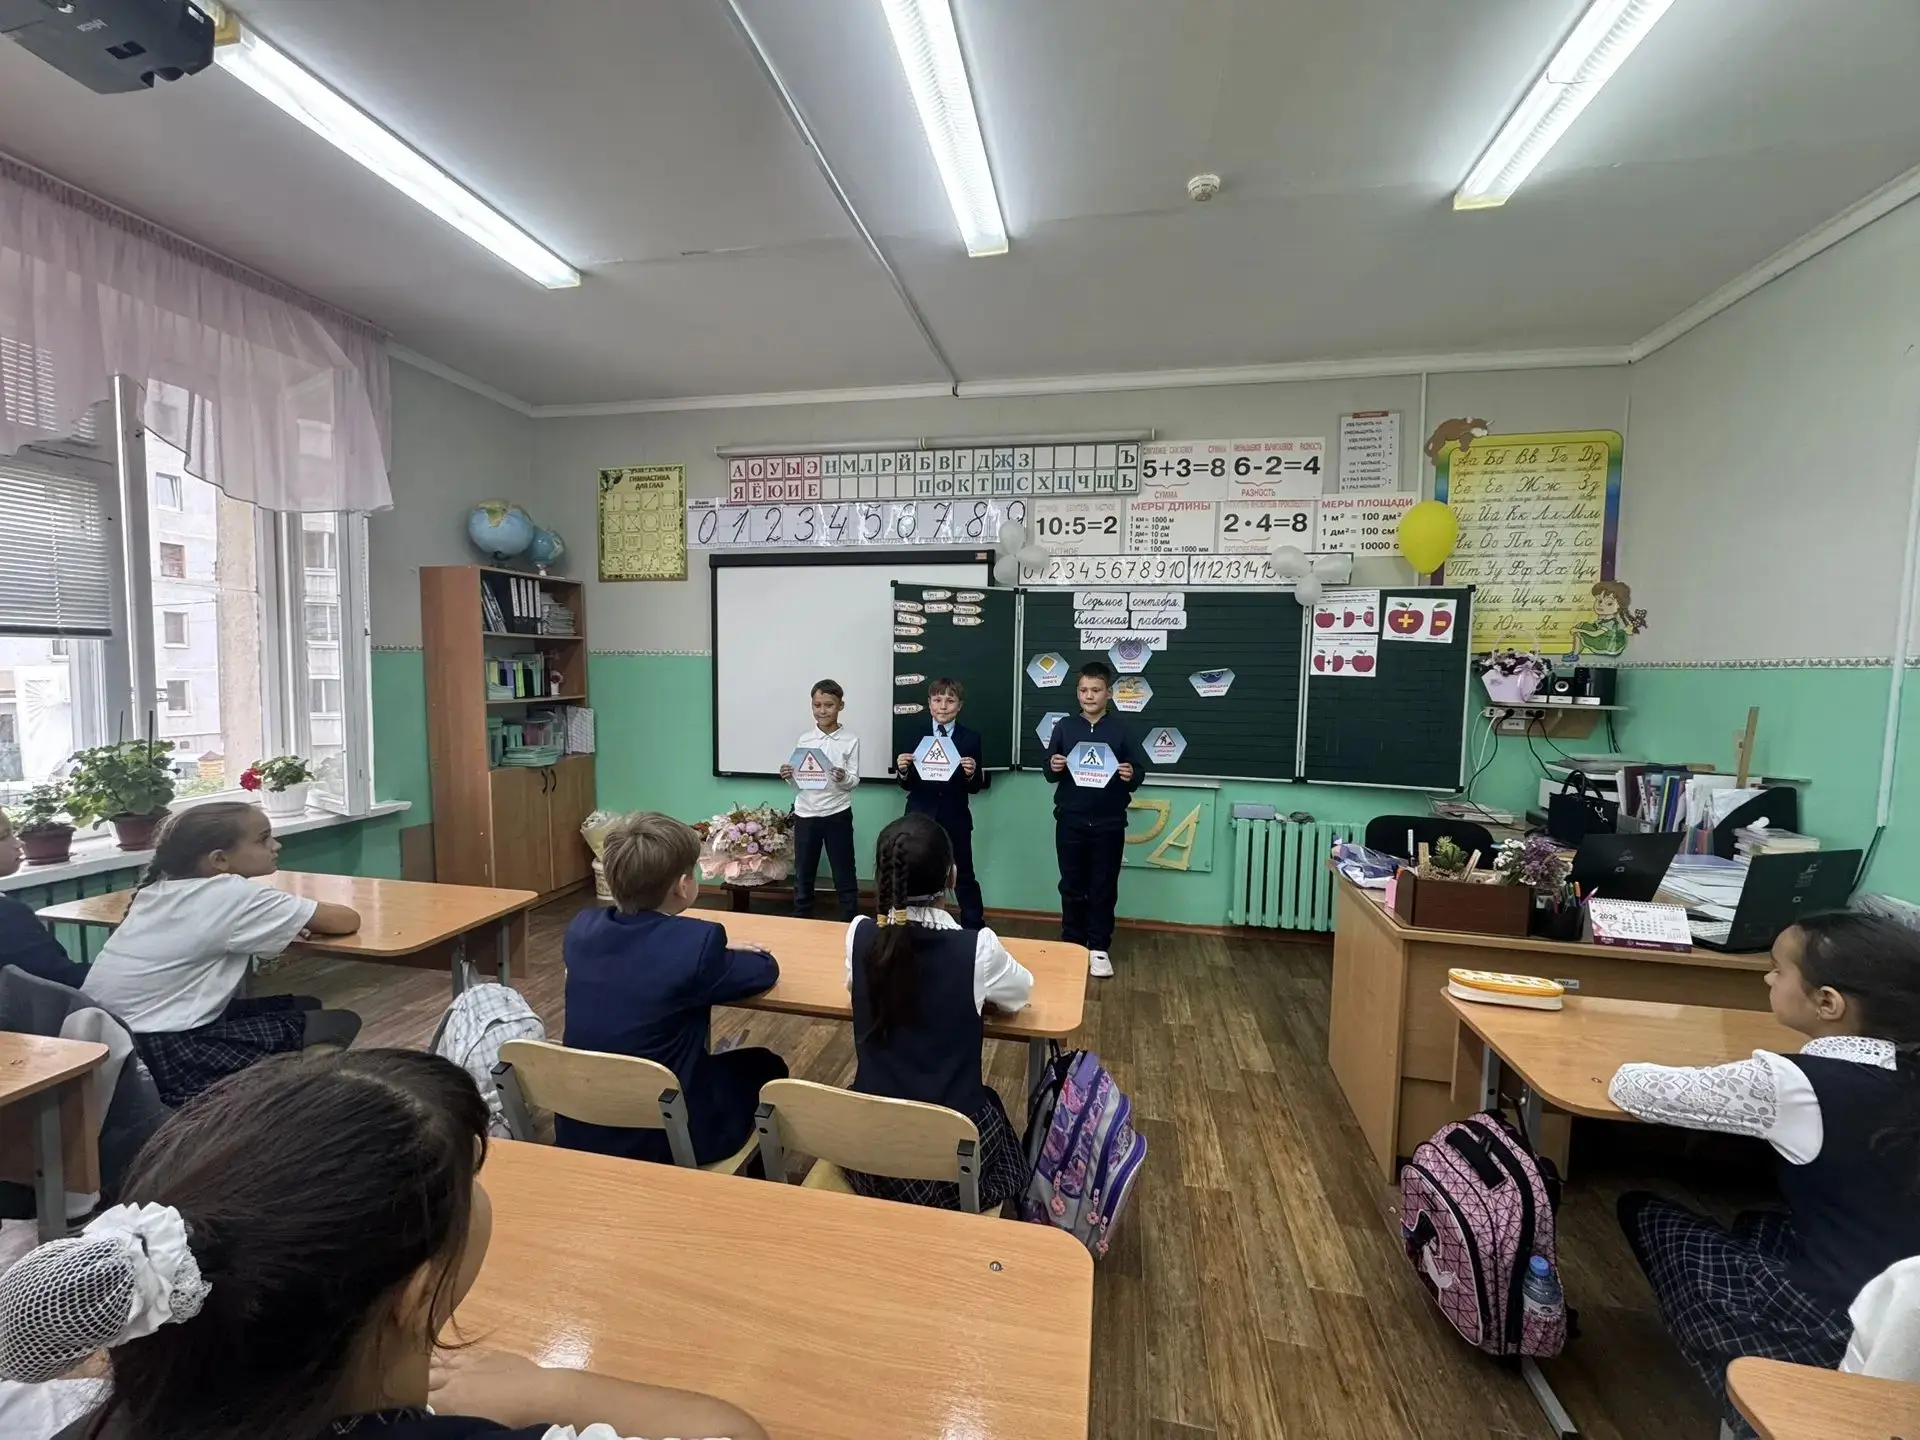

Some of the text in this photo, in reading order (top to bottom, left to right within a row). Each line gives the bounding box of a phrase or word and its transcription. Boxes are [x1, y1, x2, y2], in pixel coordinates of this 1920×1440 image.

[629, 474, 671, 482] ГИМНАСТИКА
[635, 483, 648, 491] ДЛЯ
[1154, 491, 1178, 499] СУММА
[1241, 488, 1276, 497] РАЗНОСТЬ
[1131, 502, 1164, 511] МЕРЫ
[1167, 502, 1211, 512] ДЛИНЫ
[1321, 499, 1354, 508] МЕРЫ
[1357, 498, 1413, 509] ПЛОЩАДИ
[1362, 513, 1380, 521] 100
[698, 510, 717, 544] 0
[733, 509, 749, 543] 1
[765, 507, 782, 542] 2
[794, 507, 814, 541] 3
[829, 506, 847, 541] 4
[863, 503, 882, 540] 5
[897, 503, 916, 538] 6
[934, 501, 952, 538] 7
[966, 502, 988, 538] 8
[1036, 515, 1118, 536] 10:5=2
[1361, 527, 1379, 535] 100
[1360, 542, 1390, 550] 10000
[1049, 562, 1061, 579] 2
[1065, 561, 1075, 579] 3
[1080, 561, 1090, 579] 4
[1095, 561, 1107, 579] 5
[1110, 561, 1122, 579] 6
[1125, 561, 1137, 578] 7
[1139, 560, 1151, 578] 8
[1154, 560, 1166, 578] 9
[1169, 560, 1186, 579] 10
[1192, 560, 1205, 579] 11
[1207, 560, 1223, 579] 12
[1225, 561, 1240, 579] 13
[1243, 561, 1259, 579] 14
[1082, 592, 1181, 612] Седьмое сентября.
[1074, 610, 1183, 629] Классная работа.
